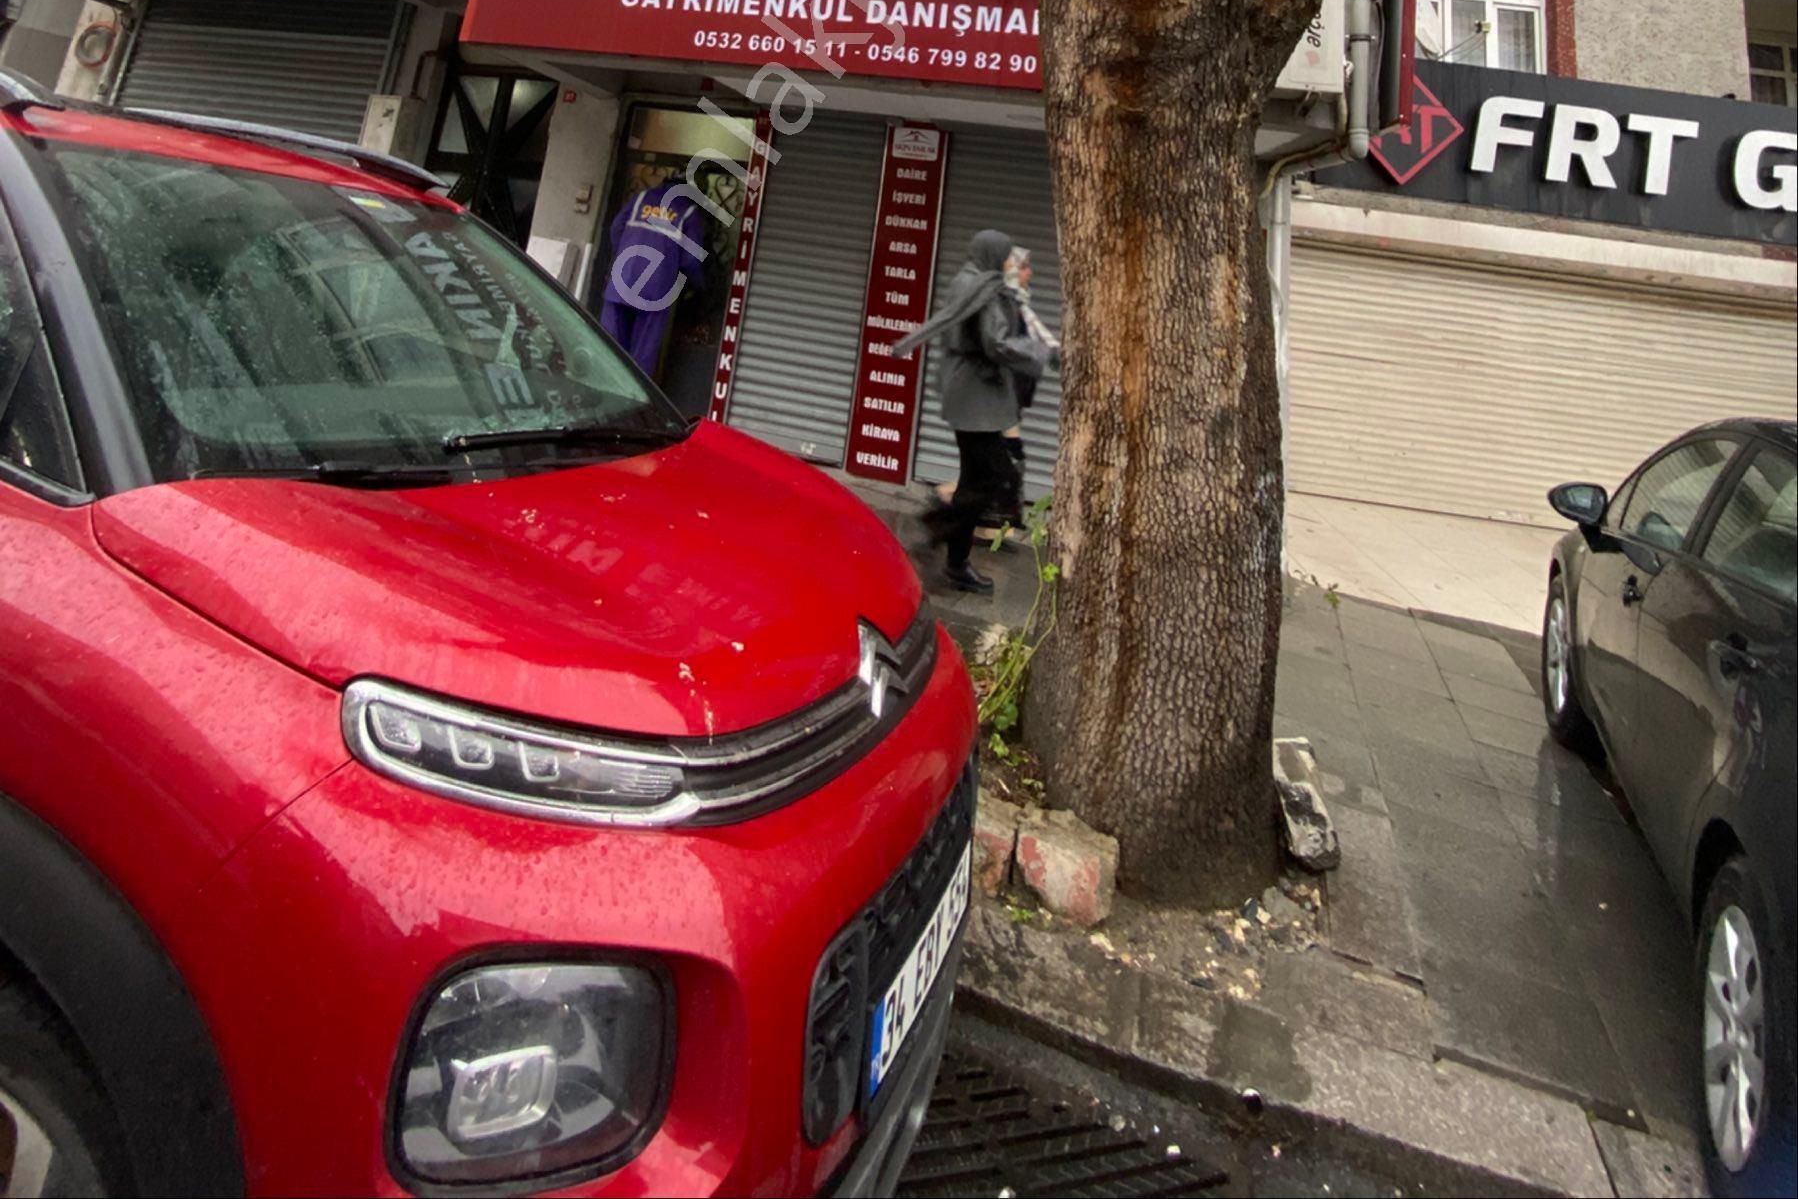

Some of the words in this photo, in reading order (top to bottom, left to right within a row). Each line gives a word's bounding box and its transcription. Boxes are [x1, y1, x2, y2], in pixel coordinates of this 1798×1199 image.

[866, 0, 1040, 37] DANIŞMA
[694, 30, 742, 50] 0532
[748, 35, 785, 53] 660
[793, 39, 816, 56] 15
[825, 41, 846, 58] 11
[868, 44, 920, 64] 0546
[928, 48, 967, 67] 799
[974, 52, 1001, 70] 82
[1010, 54, 1037, 73] 90
[1470, 95, 1699, 197] FRT
[896, 167, 928, 181] DAİRE
[885, 214, 928, 231] DÜKKAN
[888, 241, 918, 255] ARSA
[884, 265, 917, 280] TARLA
[885, 290, 910, 306] TÜM
[869, 370, 906, 387] ALINIR
[863, 396, 905, 415] SATILIR
[861, 423, 901, 442] KİRAYA
[856, 451, 899, 471] VERİLİR
[882, 973, 905, 1068] 34
